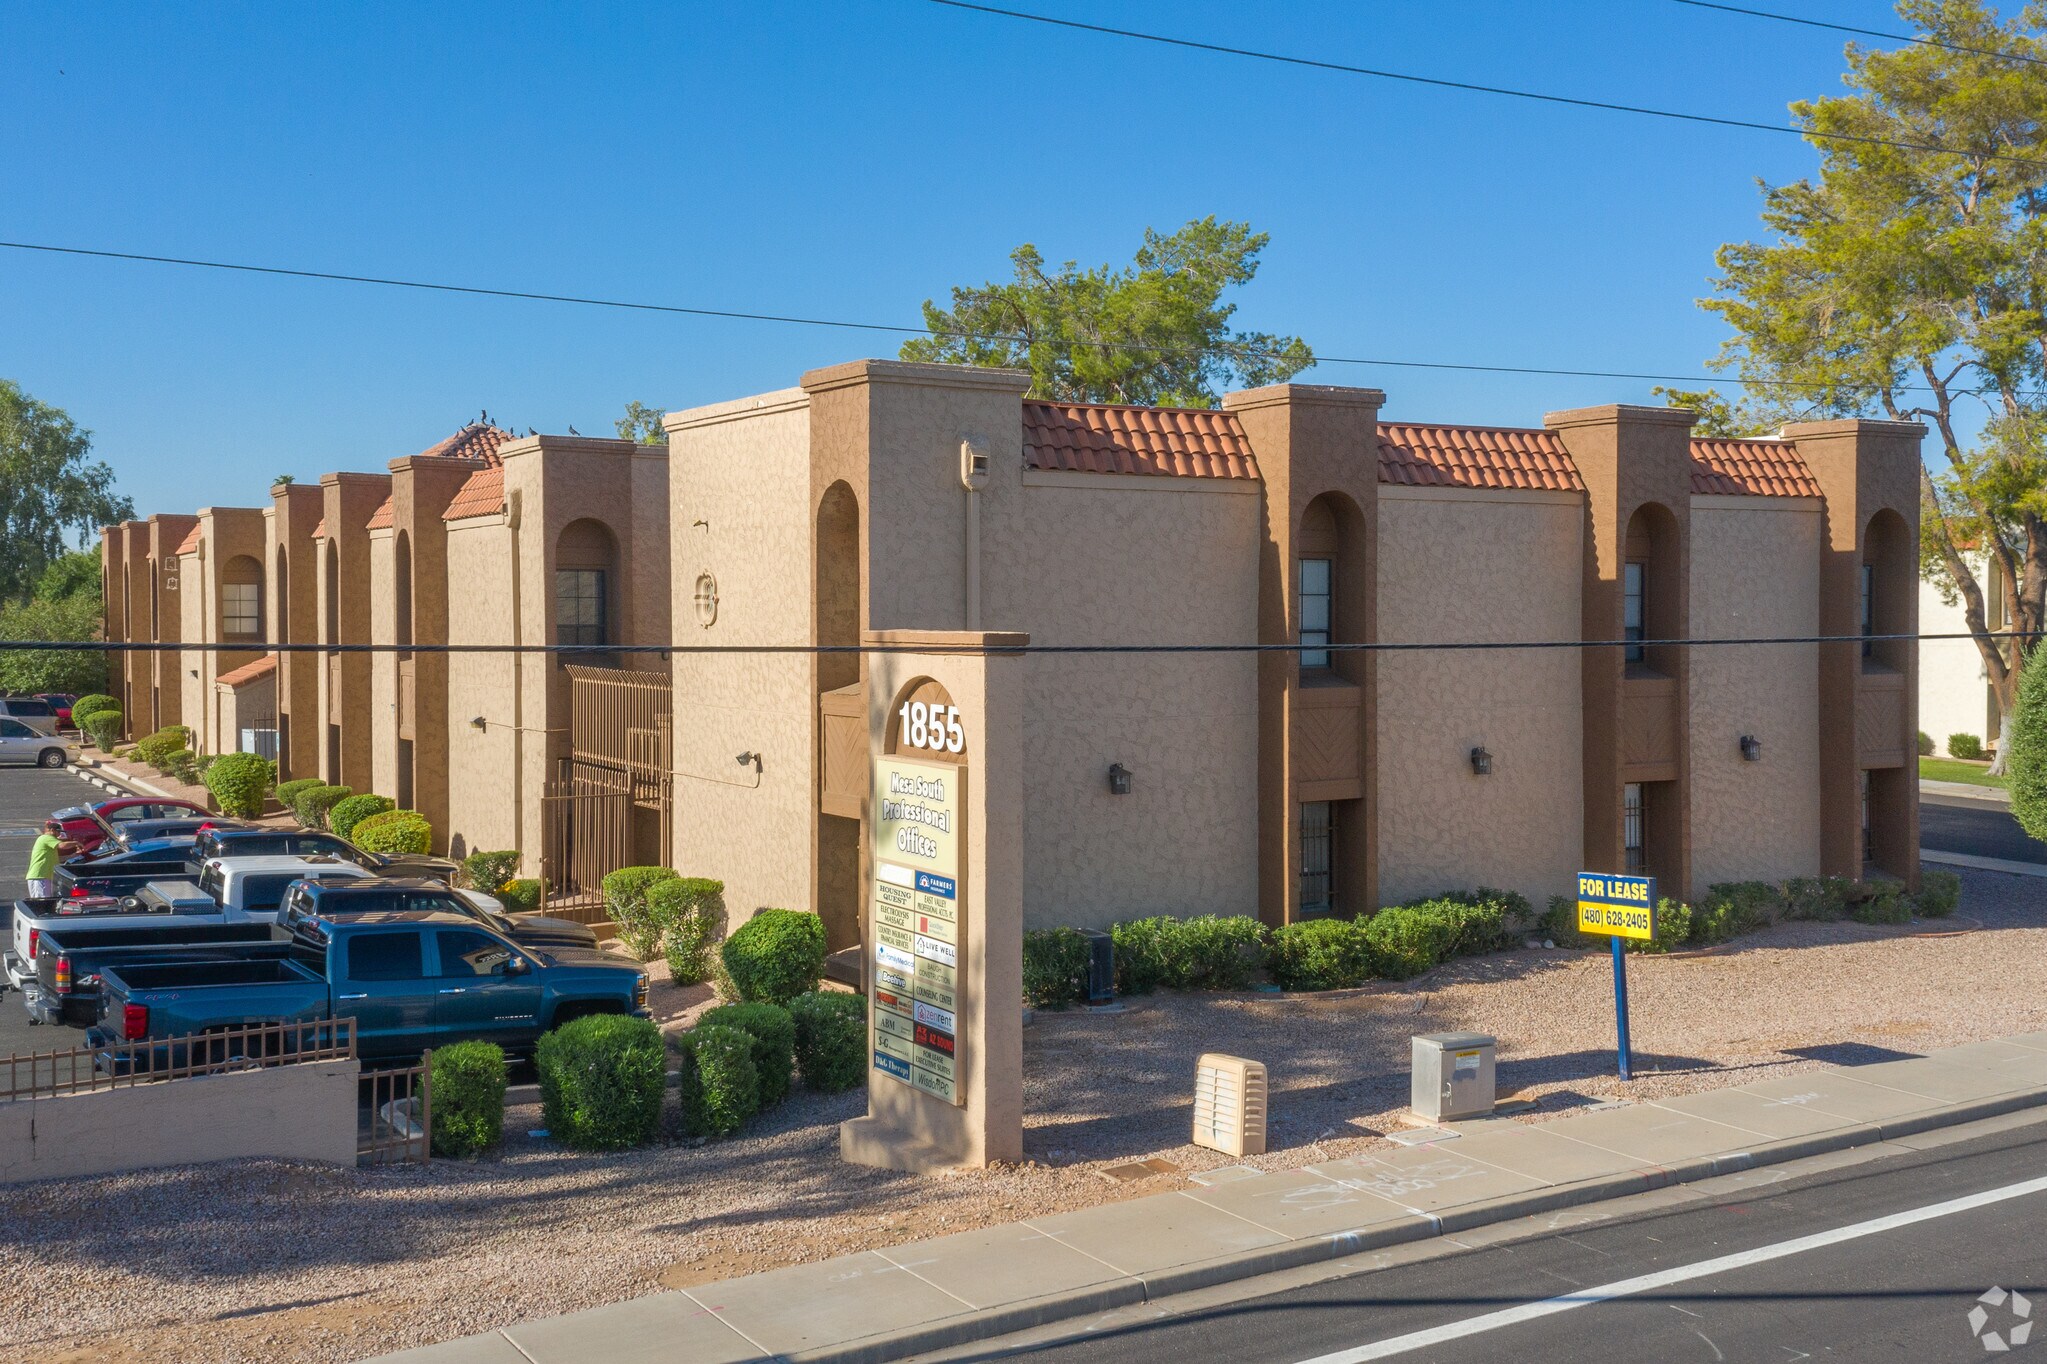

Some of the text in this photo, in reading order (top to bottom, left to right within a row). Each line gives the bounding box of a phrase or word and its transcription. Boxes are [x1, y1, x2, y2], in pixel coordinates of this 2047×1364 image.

[899, 702, 964, 753] 1855
[891, 772, 944, 802] Mesa South
[883, 798, 950, 833] Professional
[897, 826, 937, 858] Offices
[880, 885, 911, 899] HOUSING
[930, 879, 952, 890] FARMERS
[1580, 878, 1648, 901] FOR LEASE
[883, 893, 907, 905] QUEST
[924, 895, 947, 908] EAST VALLEY
[881, 905, 909, 920] ELECTROLYSIS
[885, 914, 905, 926] MASSAGE
[1581, 908, 1648, 929] (480) 628-2405
[926, 942, 938, 952] LIVE
[940, 946, 955, 958] WELL
[882, 970, 906, 988] Beehive
[880, 1018, 895, 1030] ABM
[926, 1009, 952, 1027] zenrent
[922, 1050, 944, 1064] FOR LEASE
